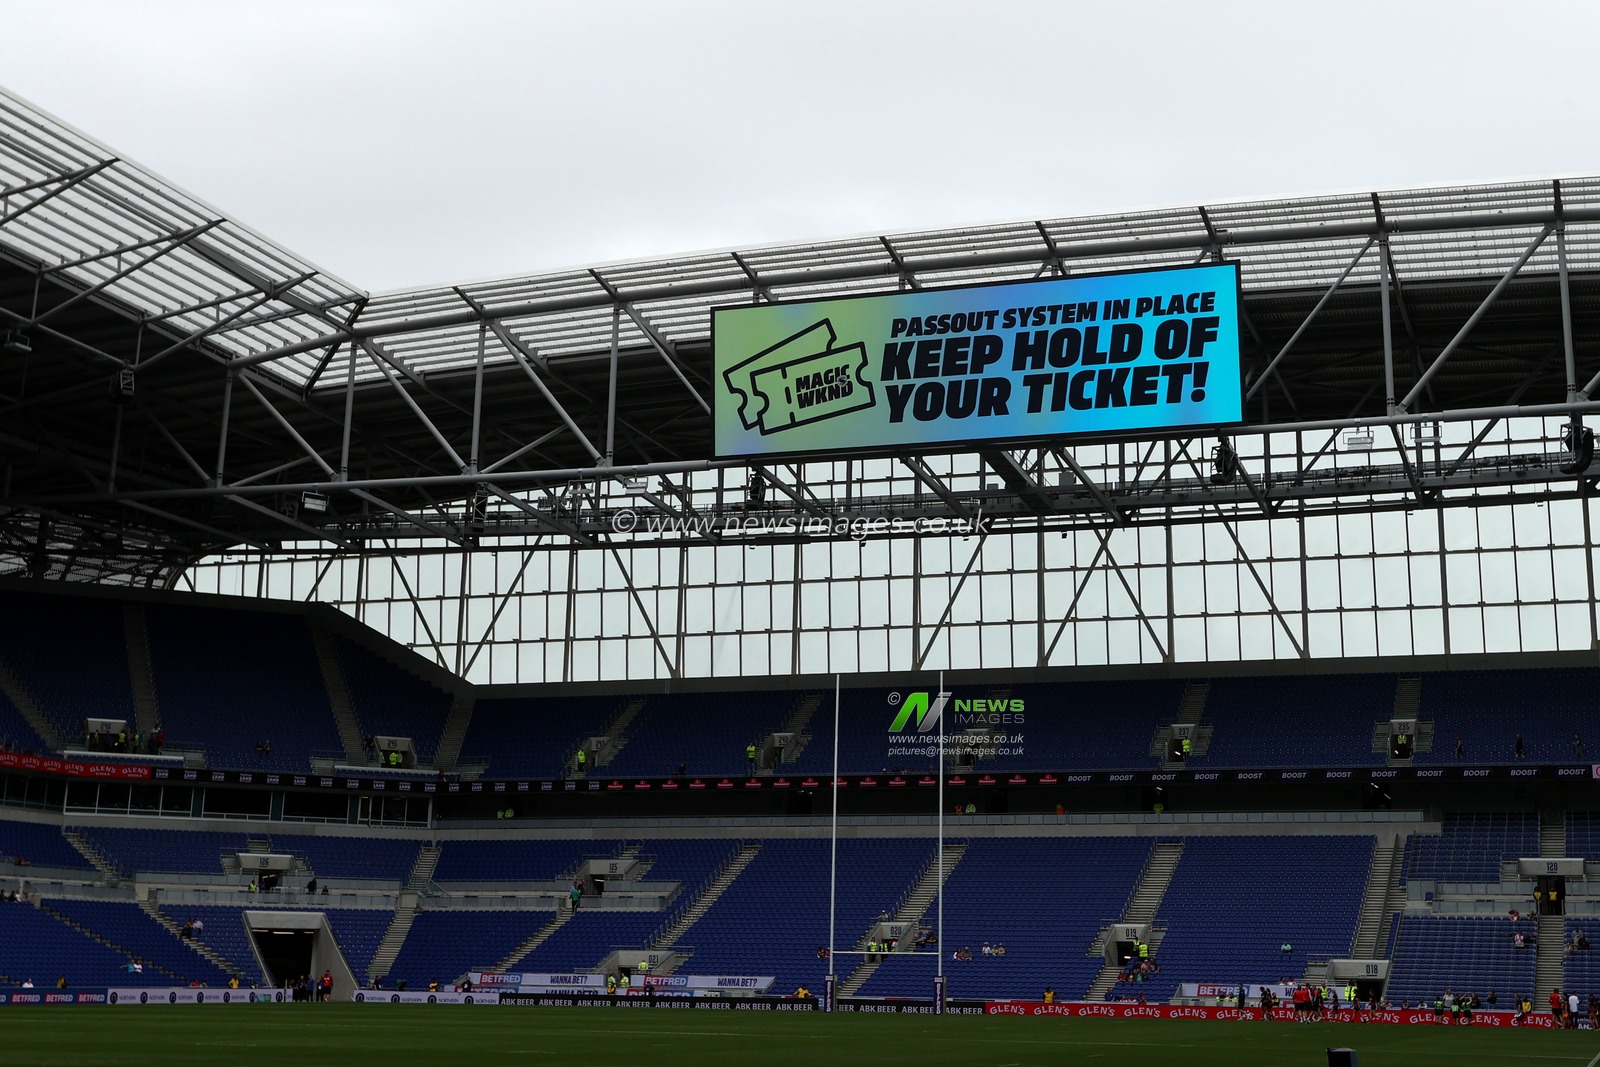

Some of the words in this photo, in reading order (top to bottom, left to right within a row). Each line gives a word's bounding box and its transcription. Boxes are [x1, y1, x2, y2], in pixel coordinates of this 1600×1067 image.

[891, 310, 1000, 338] PASSOUT
[1002, 303, 1097, 329] SYSTEM
[1102, 301, 1129, 320] IN
[1135, 291, 1216, 317] PLACE
[881, 334, 1003, 381] KEEP
[1011, 322, 1143, 372] HOLD
[1153, 316, 1220, 360] OF
[796, 364, 850, 393] MAGIC
[797, 380, 853, 409] WKND
[885, 376, 1010, 424] YOUR
[1023, 362, 1210, 415] TICKET!
[1178, 727, 1190, 736] 237
[90, 766, 116, 774] GLEN'S
[122, 766, 148, 776] GLEN'S
[1546, 862, 1558, 871] 120
[890, 926, 902, 935] 020
[1126, 928, 1136, 937] 019
[648, 954, 659, 964] 021
[1366, 965, 1378, 974] 018
[481, 974, 521, 984] BETFRED
[550, 975, 572, 984] WANNA
[572, 975, 588, 984] BET?
[645, 976, 687, 986] BETFRED
[718, 978, 739, 987] WANNA
[740, 978, 757, 987] BET?
[12, 993, 40, 1003] BETFRED
[46, 993, 73, 1003] BETFRED
[78, 993, 105, 1003] BETFRED
[990, 1005, 1025, 1015] GLEN'S
[1034, 1006, 1070, 1016] GLEN'S
[1078, 1006, 1115, 1017] GLEN'S
[1124, 1007, 1161, 1018] GLEN'S
[1170, 1008, 1207, 1019] GLEN'S
